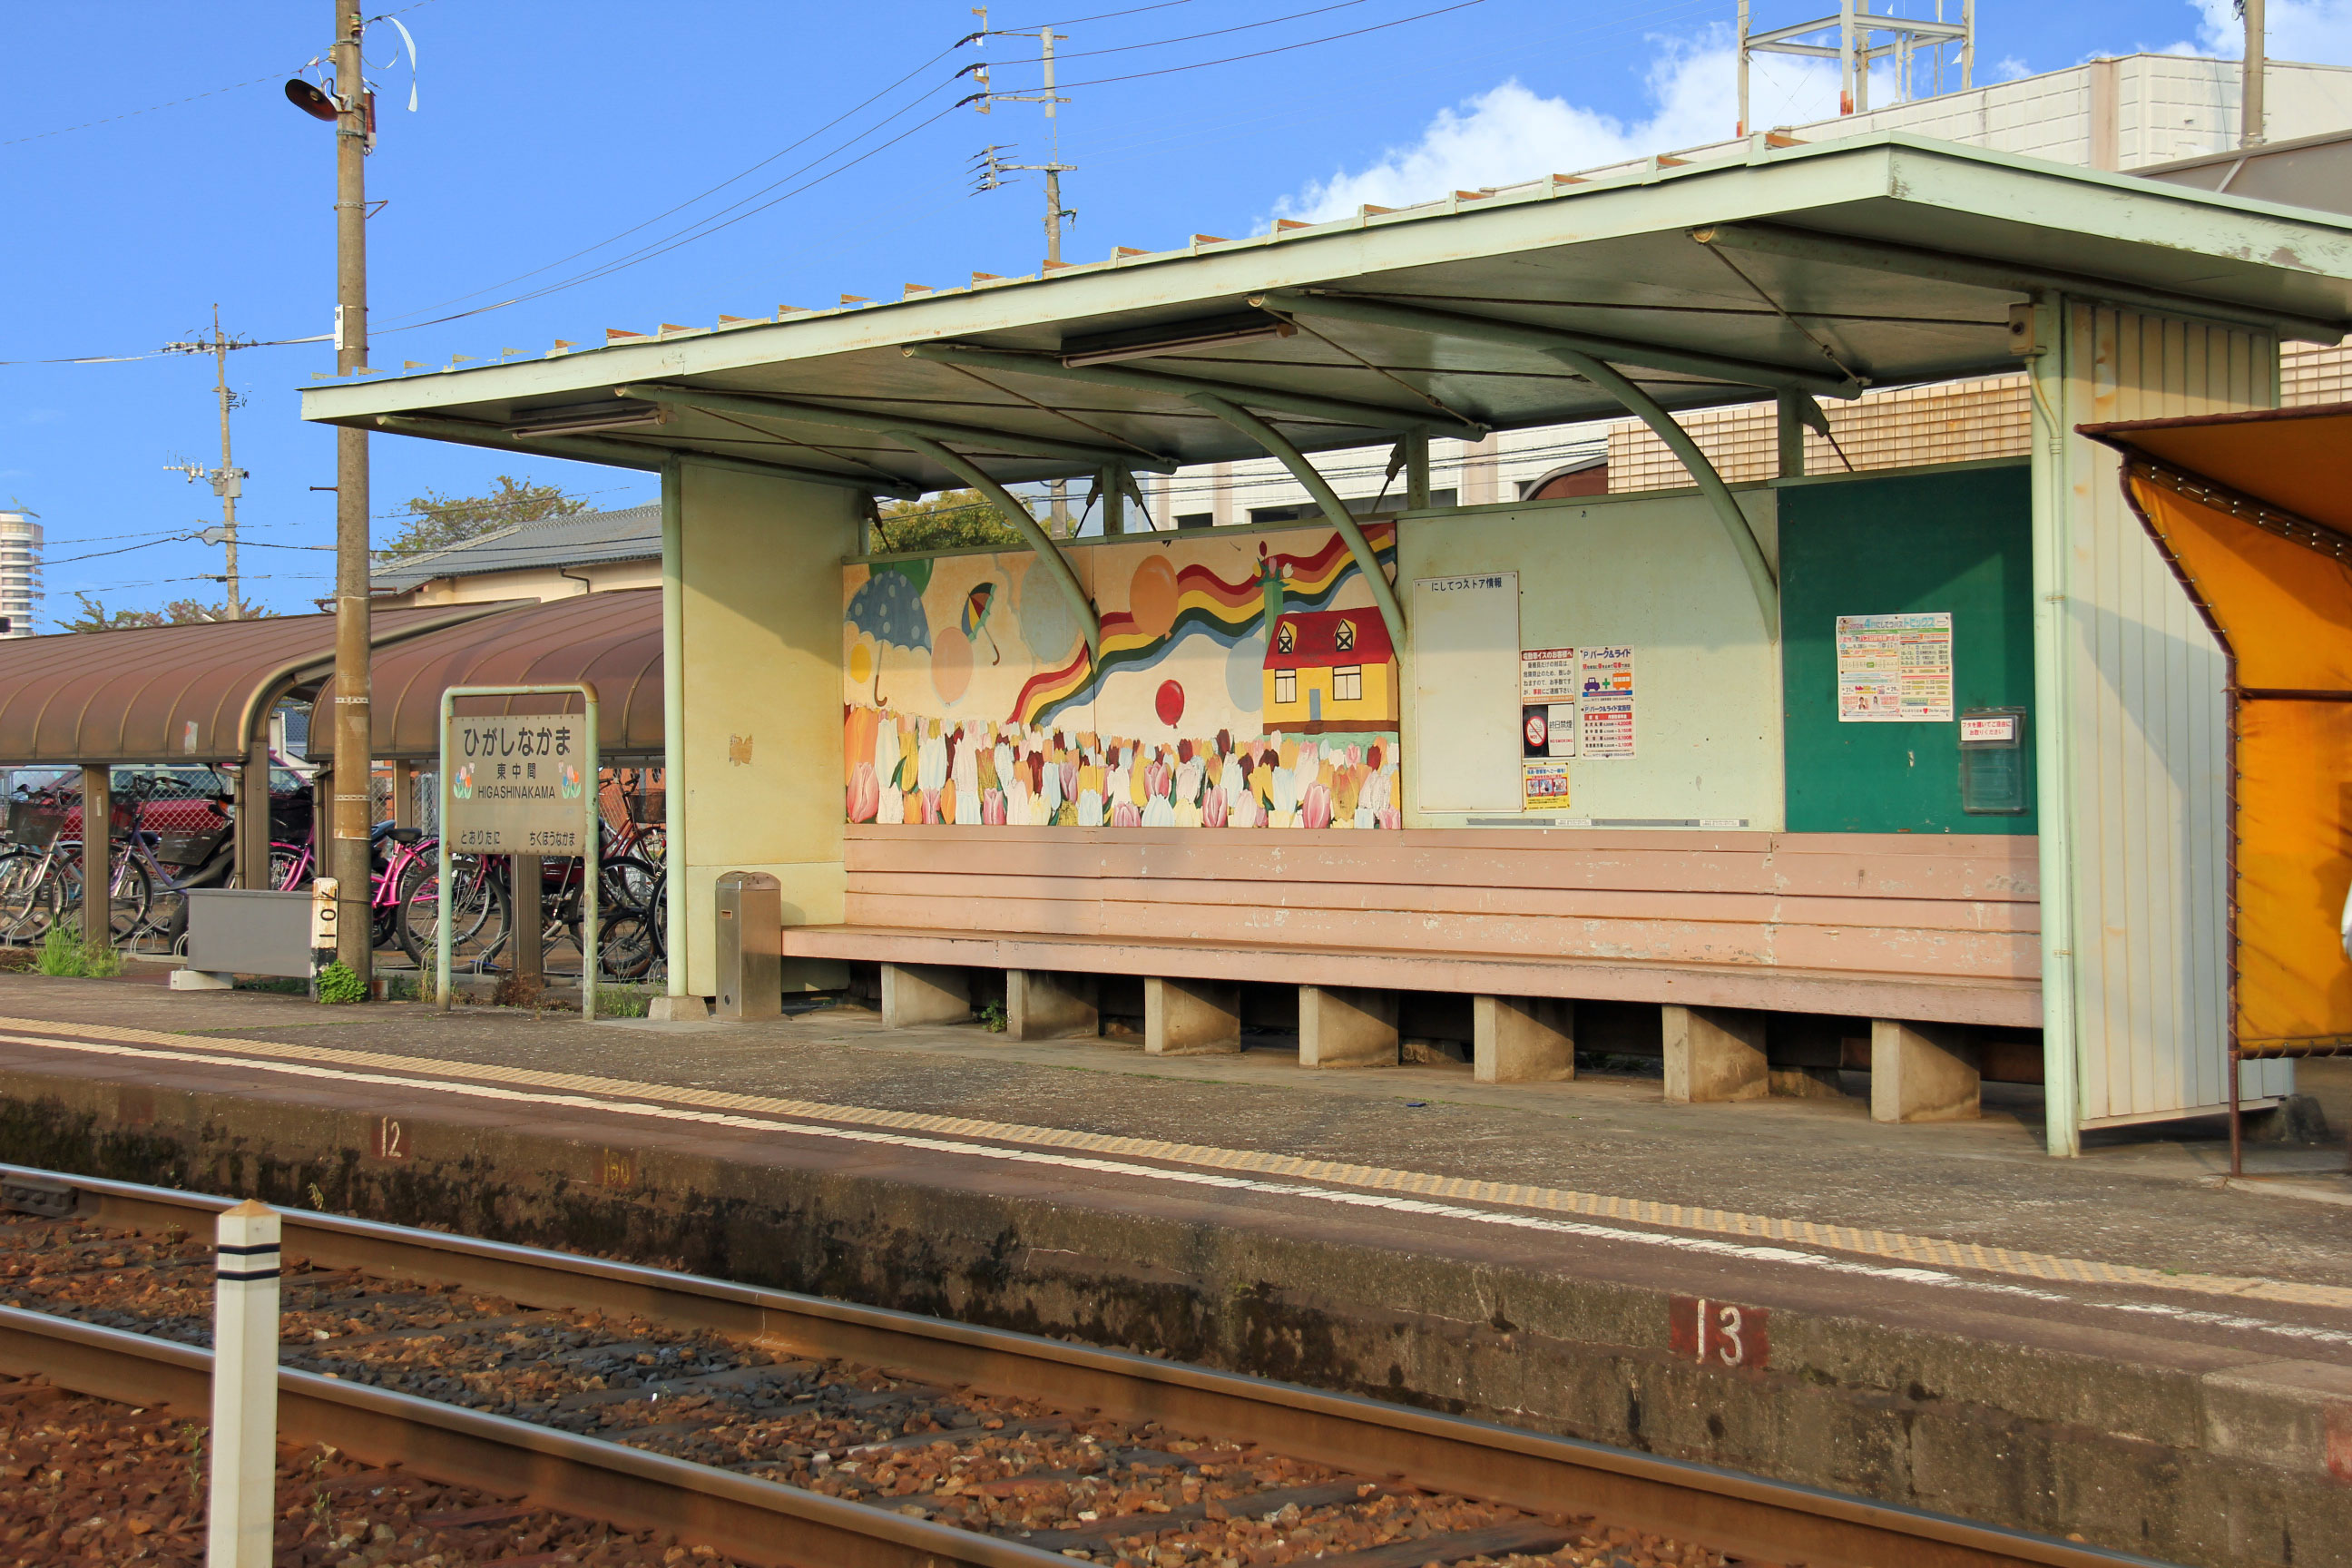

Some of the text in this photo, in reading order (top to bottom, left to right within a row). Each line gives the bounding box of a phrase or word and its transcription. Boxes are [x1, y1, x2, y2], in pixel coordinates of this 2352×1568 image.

[1431, 577, 1502, 592] にしてつストア情報
[1549, 720, 1573, 729] 終日禁煙
[464, 726, 571, 757] ひがしなかま
[496, 762, 536, 780] 東中間
[477, 785, 556, 799] HIGASHINAKAMA
[461, 830, 501, 845] とおりたに
[529, 831, 576, 846] ちくほうなかま
[382, 1116, 402, 1158] 12
[1696, 1298, 1743, 1367] 13
